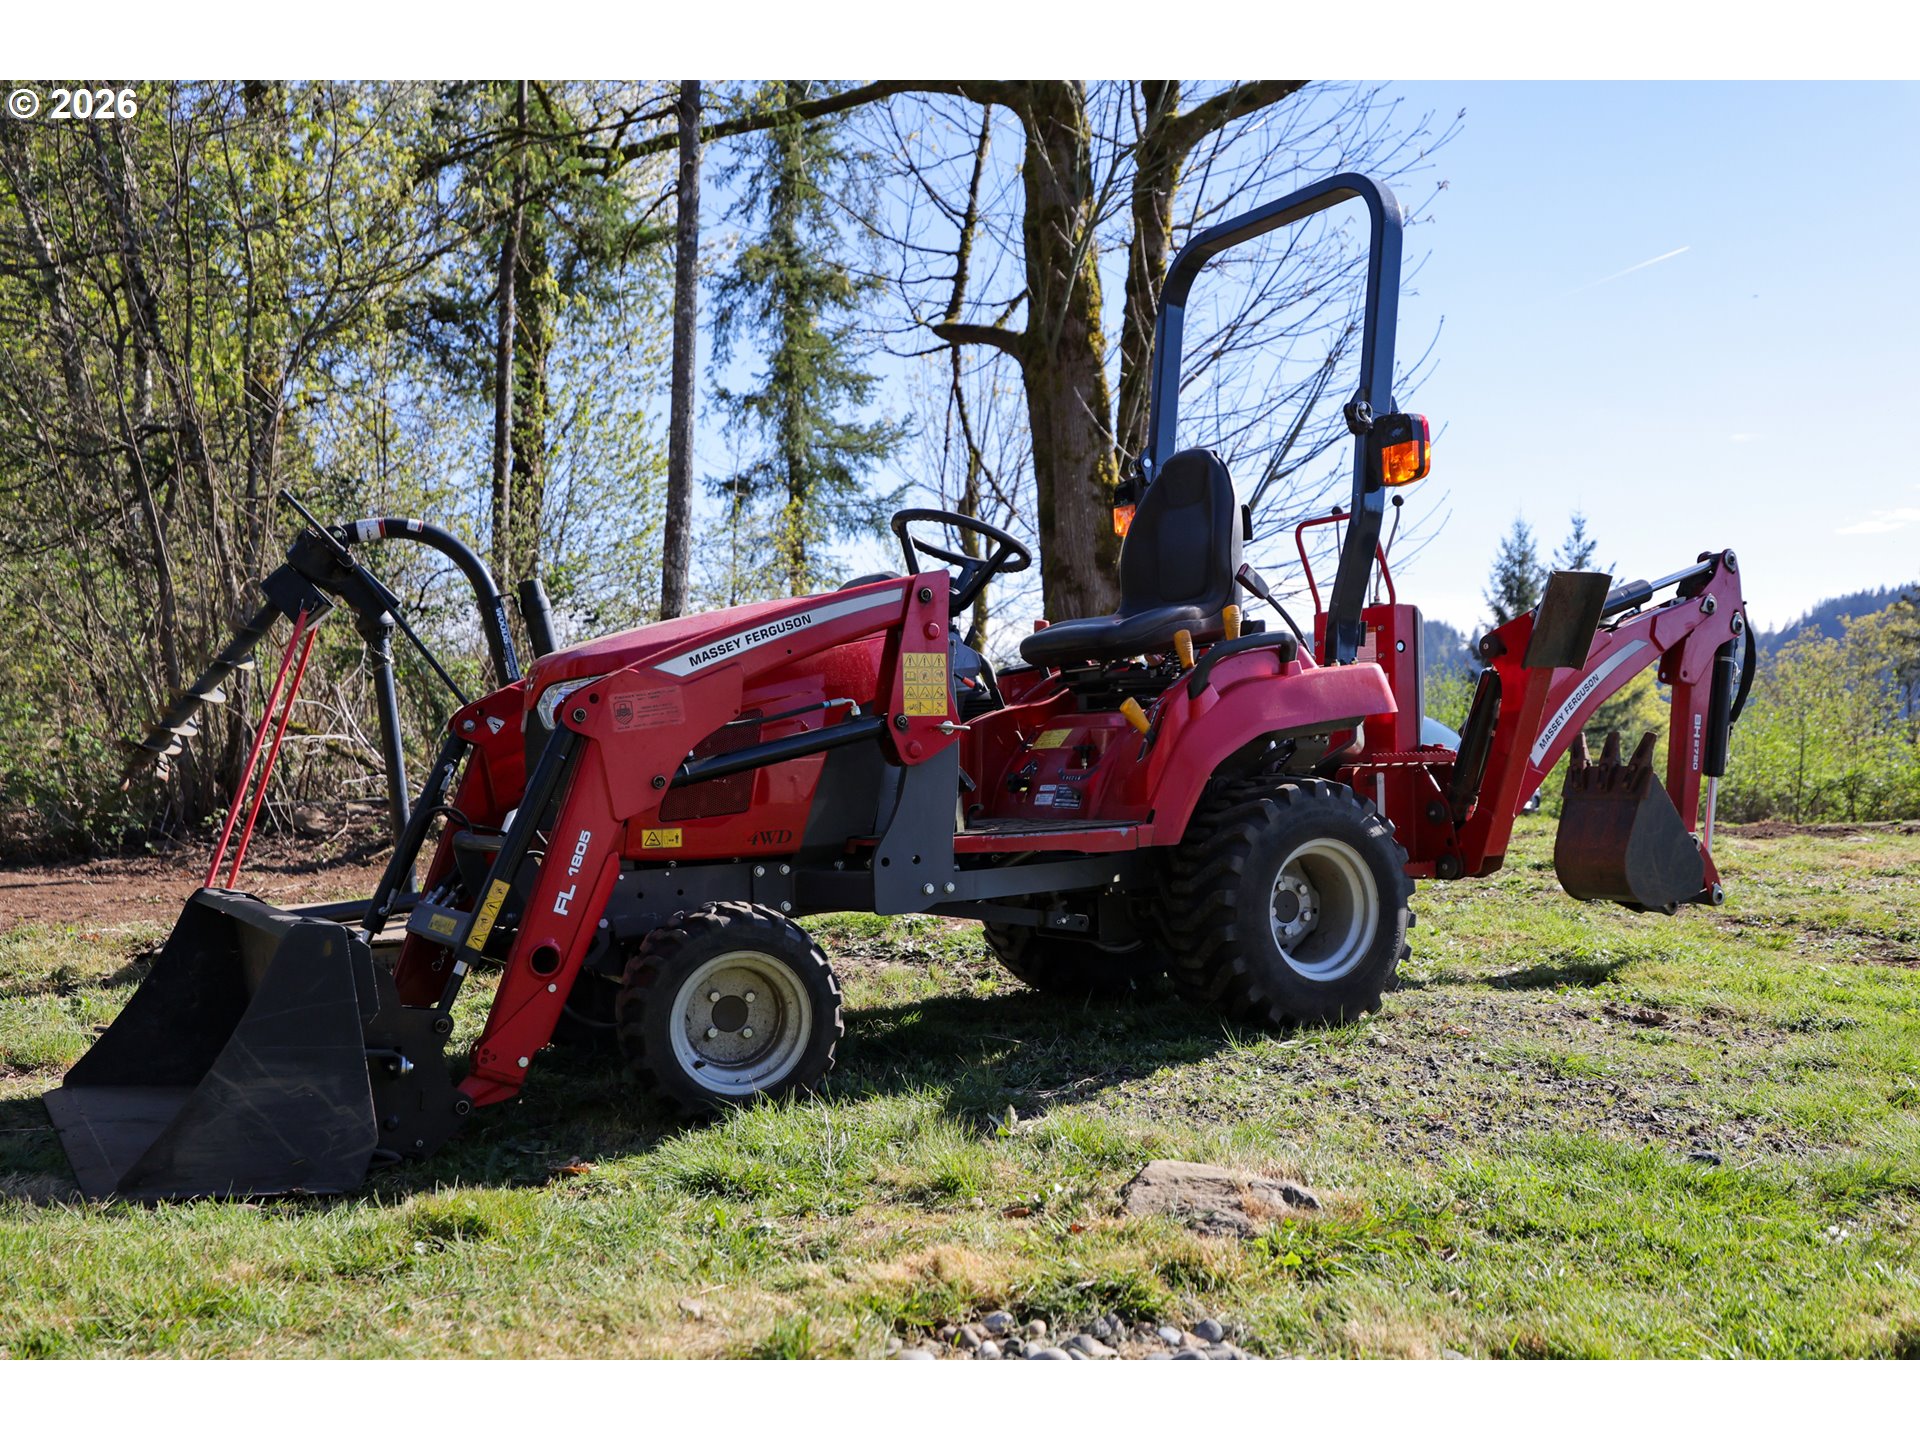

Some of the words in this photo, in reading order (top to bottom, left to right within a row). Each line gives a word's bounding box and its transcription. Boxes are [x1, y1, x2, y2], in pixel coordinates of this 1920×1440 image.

[495, 607, 510, 644] WOODS
[688, 638, 741, 667] MASSEY
[745, 614, 812, 645] FERGUSON
[1539, 713, 1565, 750] MASSEY
[1564, 673, 1600, 715] FERGUSON
[747, 830, 793, 846] 4WD
[553, 884, 577, 916] FL
[568, 829, 591, 876] 1805
